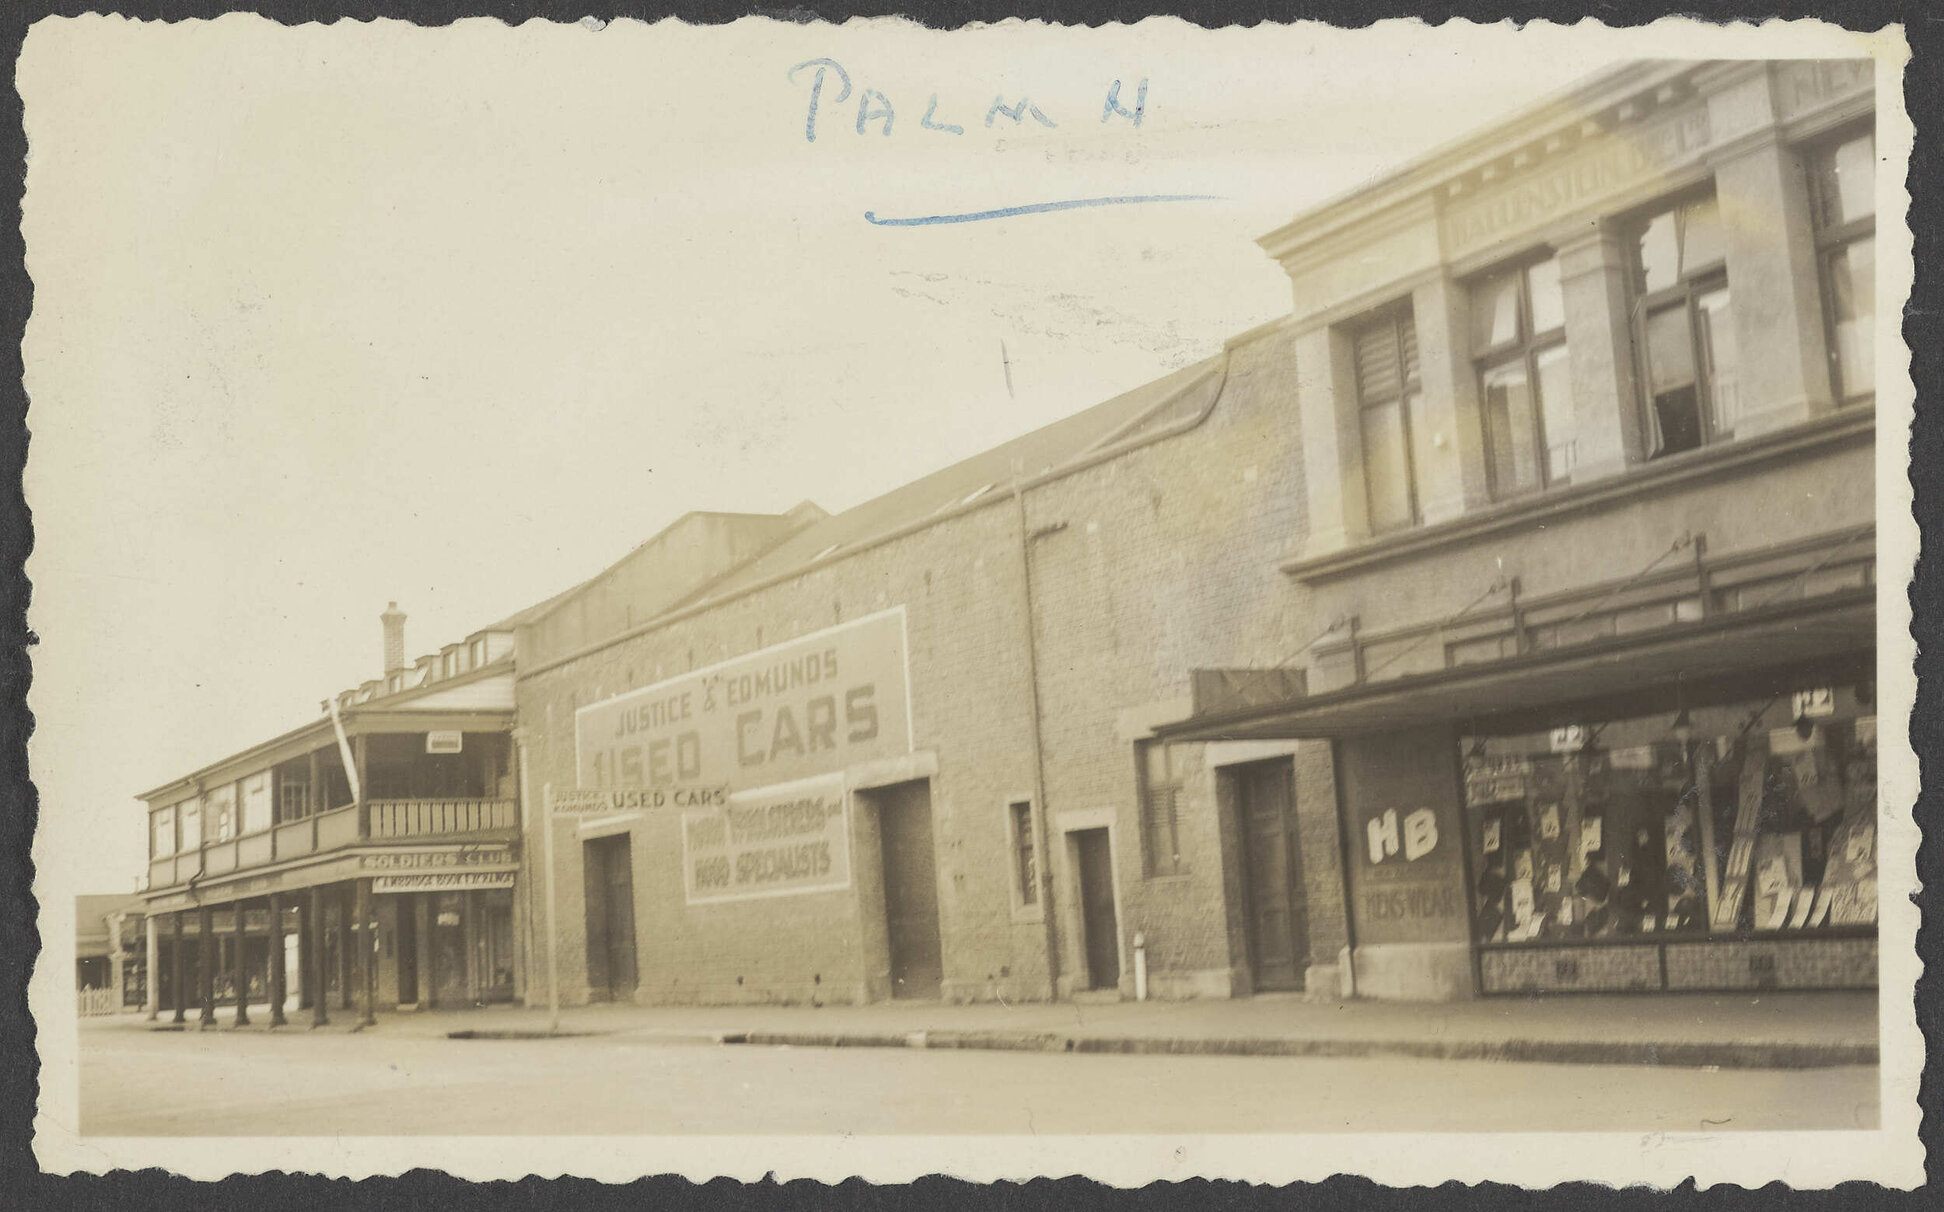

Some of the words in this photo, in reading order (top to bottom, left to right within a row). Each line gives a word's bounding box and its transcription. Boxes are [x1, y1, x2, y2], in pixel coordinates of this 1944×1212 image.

[788, 57, 1058, 143] PALM
[614, 691, 693, 739] JUSTICE
[727, 648, 838, 708] EDMUNDS
[736, 682, 880, 768] CARS
[612, 790, 666, 809] USED
[673, 788, 728, 807] CARS
[464, 850, 513, 867] CLUB
[735, 840, 832, 886] SPECIALISTS
[1366, 807, 1439, 866] HB
